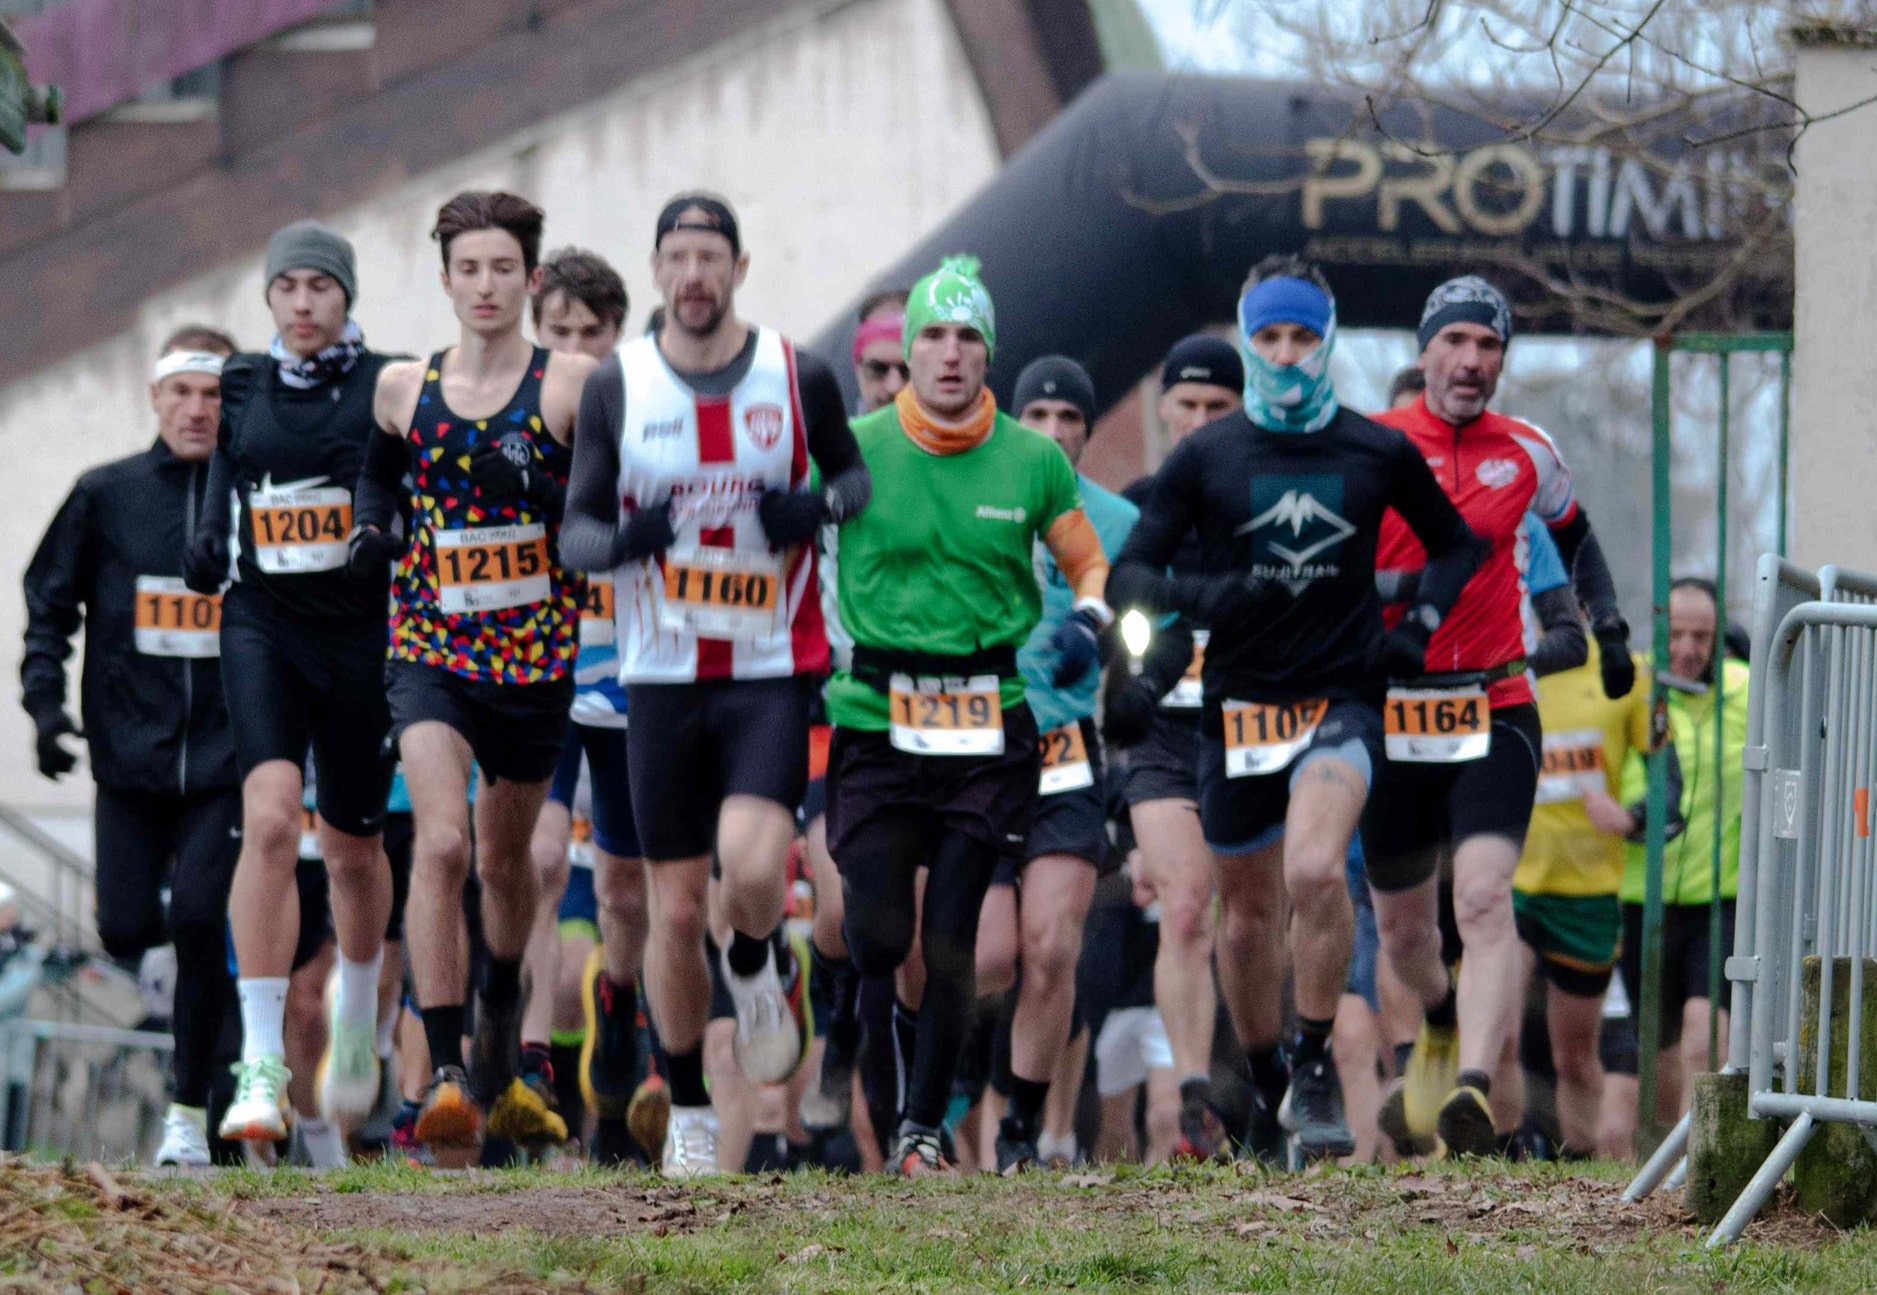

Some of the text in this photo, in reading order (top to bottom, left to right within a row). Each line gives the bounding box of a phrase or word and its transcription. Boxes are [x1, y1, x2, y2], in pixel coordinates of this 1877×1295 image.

[259, 508, 344, 543] 1204
[976, 505, 1013, 521] Allianz
[445, 540, 540, 583] 1215
[674, 567, 768, 608] 1160
[147, 595, 223, 629] 110
[899, 694, 991, 728] 1219
[1392, 700, 1480, 733] 1164
